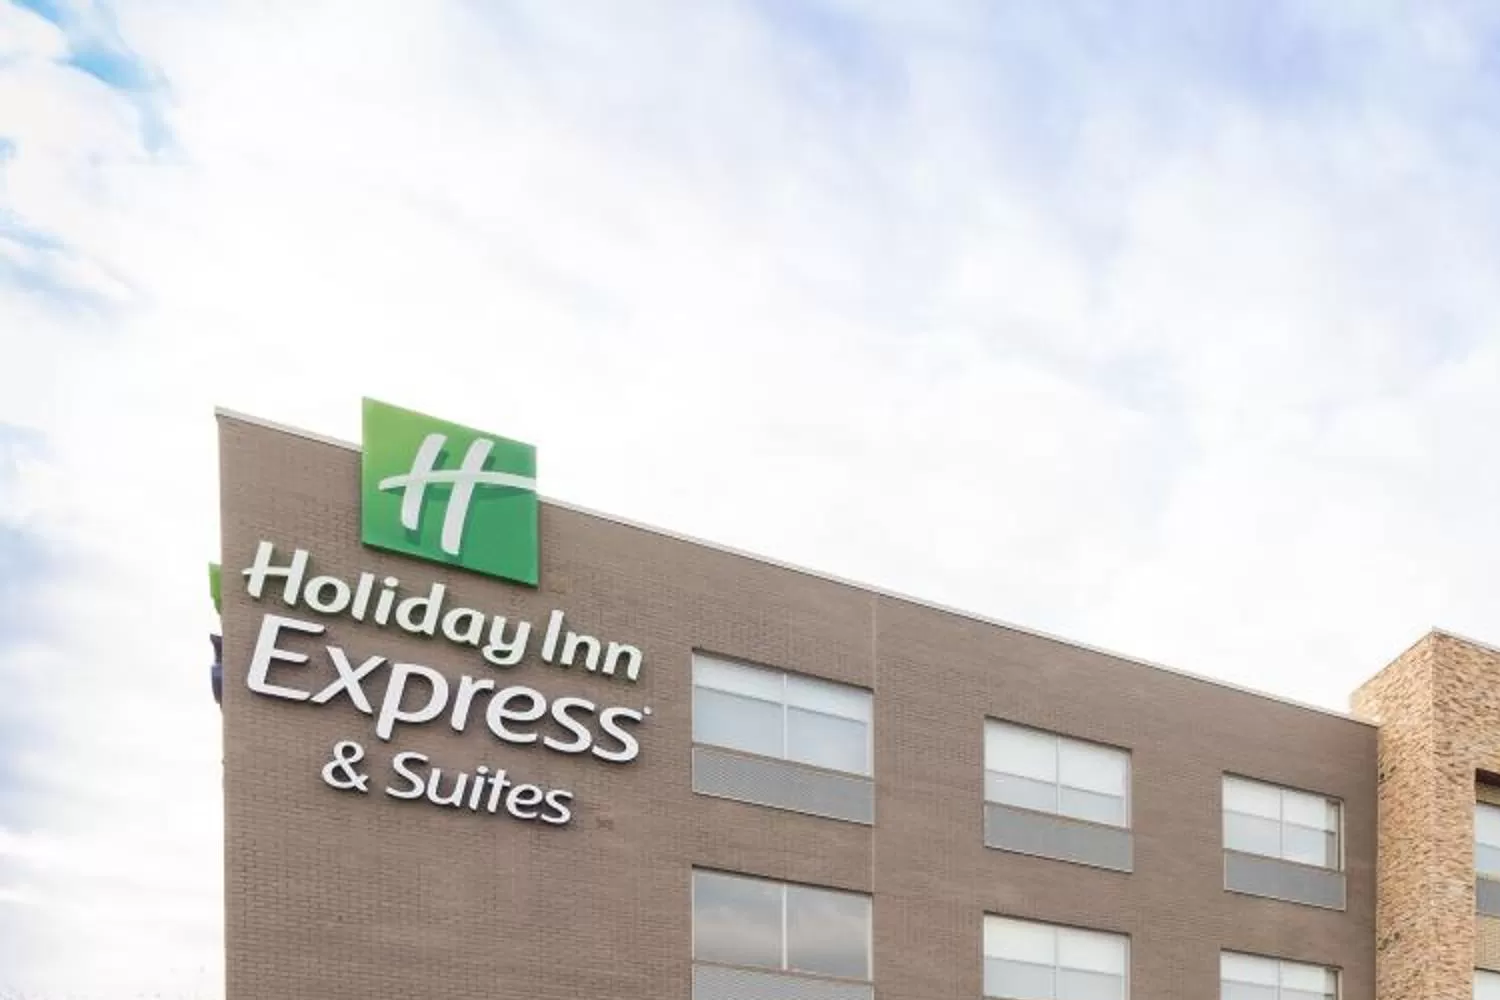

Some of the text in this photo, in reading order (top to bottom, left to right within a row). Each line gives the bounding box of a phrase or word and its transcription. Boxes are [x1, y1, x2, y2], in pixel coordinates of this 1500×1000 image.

[241, 541, 644, 682] Holiday Inn
[247, 614, 644, 764] Express
[321, 740, 575, 826] & Suites
